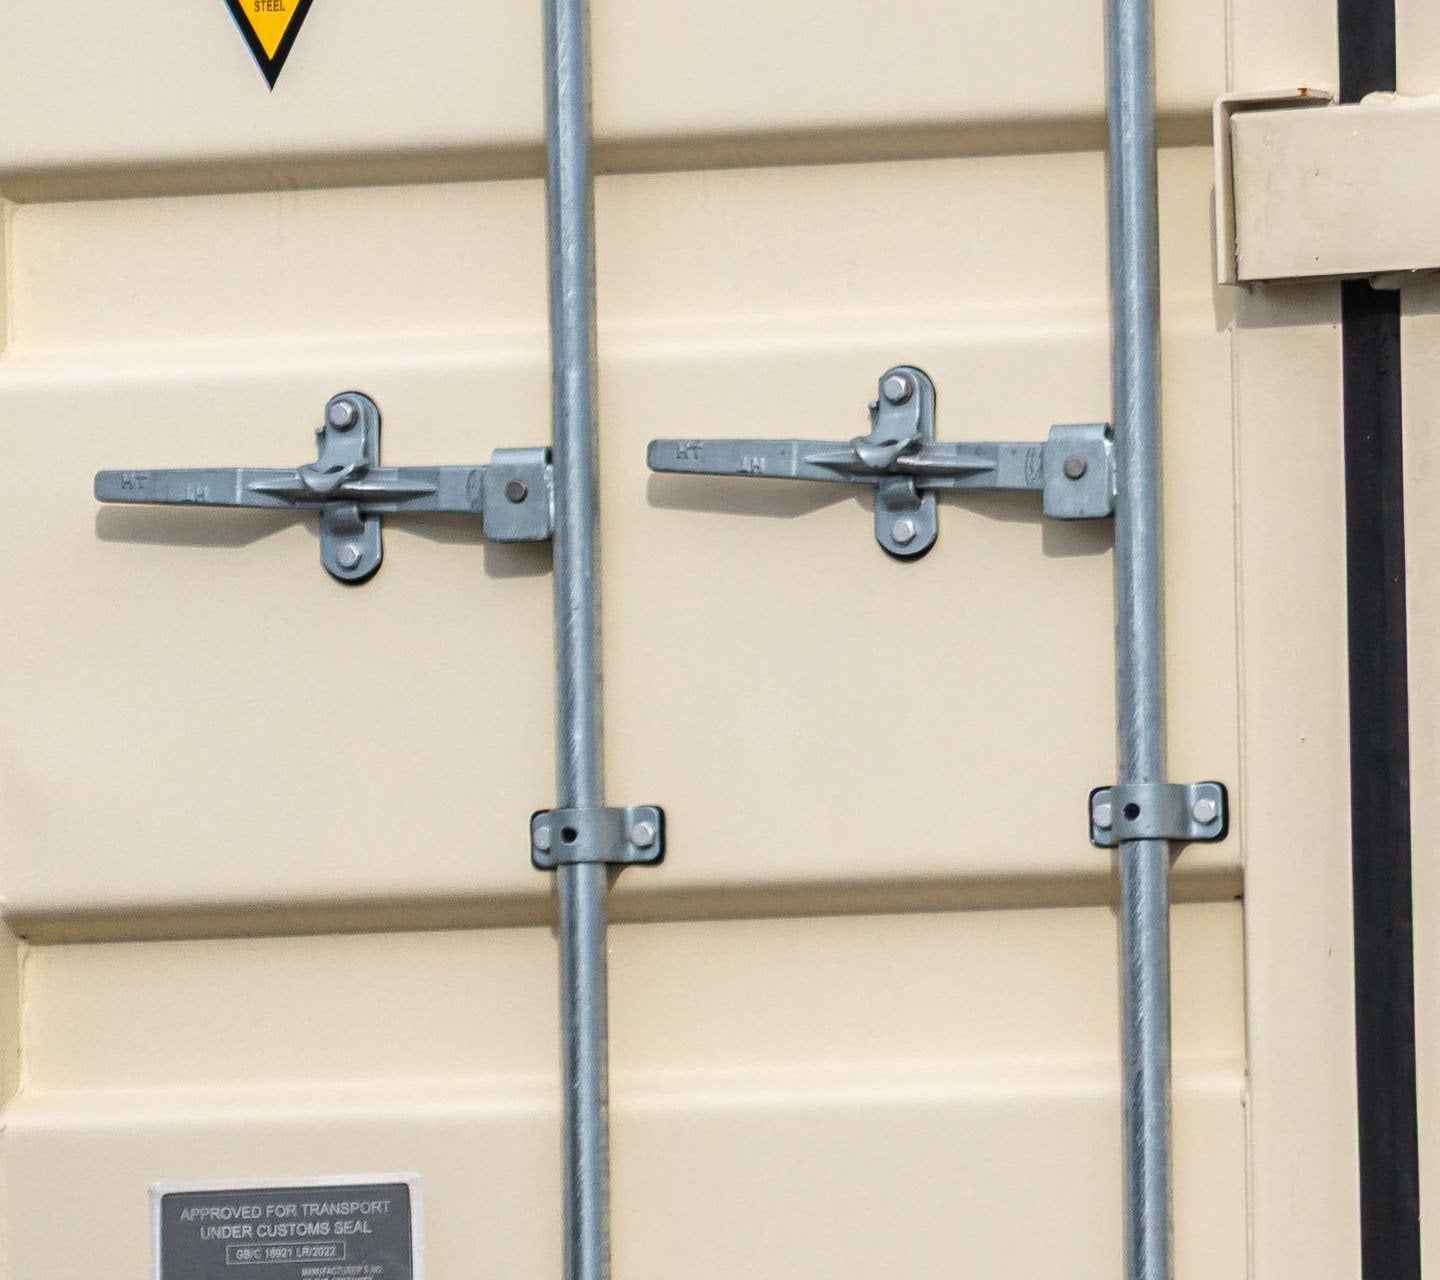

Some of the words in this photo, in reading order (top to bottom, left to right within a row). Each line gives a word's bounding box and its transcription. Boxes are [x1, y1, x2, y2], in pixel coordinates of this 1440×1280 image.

[253, 0, 286, 13] STEEL
[180, 1204, 262, 1222] APPROVED
[266, 1204, 297, 1218] FOR
[301, 1200, 391, 1216] TRANSPORT
[200, 1224, 253, 1240] UNDER
[257, 1222, 330, 1237] CUSTOMS
[334, 1219, 372, 1234] SEAL
